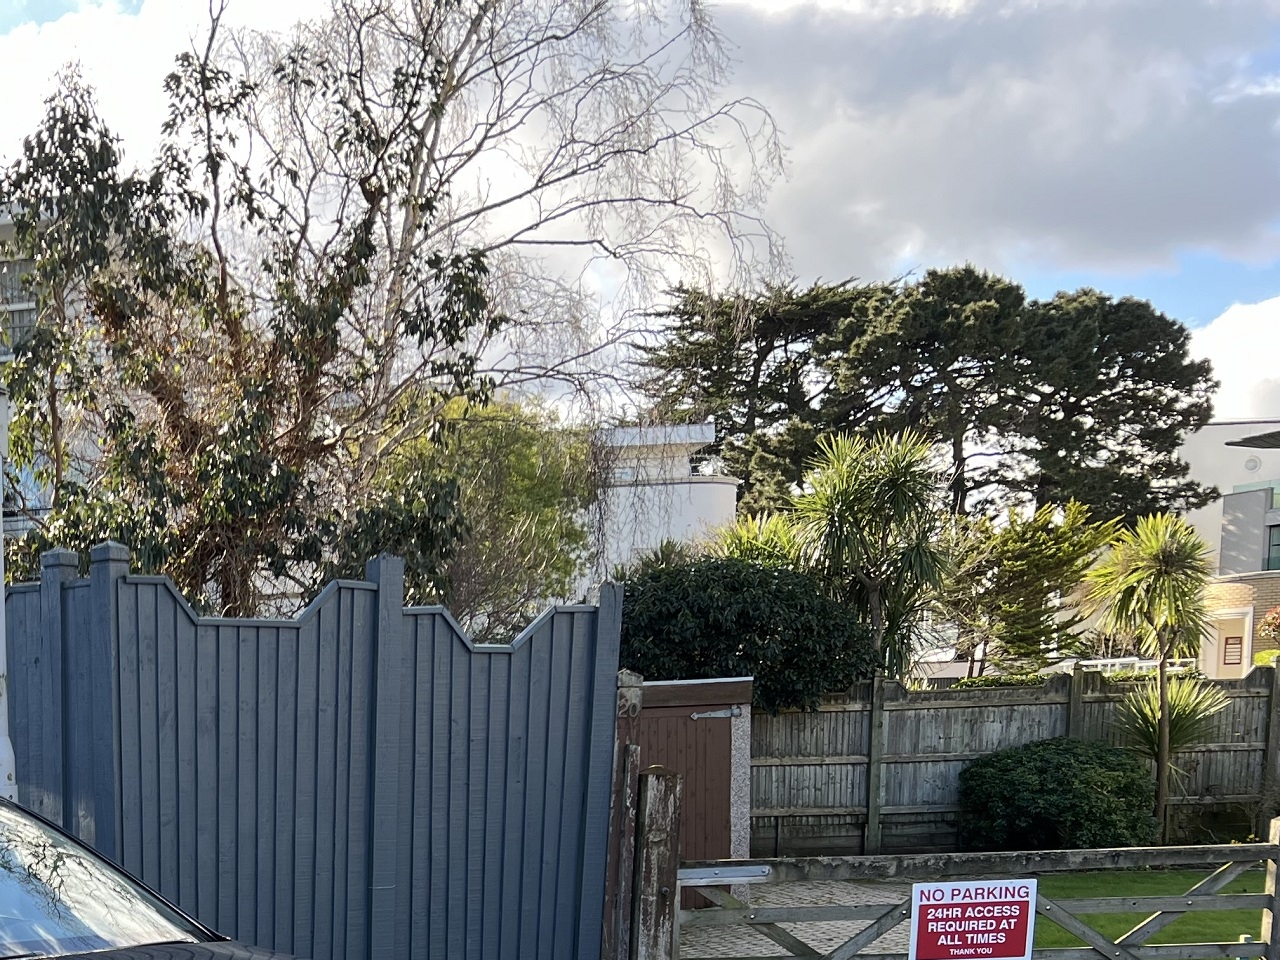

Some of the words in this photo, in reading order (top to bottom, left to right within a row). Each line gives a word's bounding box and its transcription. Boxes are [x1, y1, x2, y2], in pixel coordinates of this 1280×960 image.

[920, 888, 945, 902] NO
[951, 885, 1030, 901] PARKING
[927, 907, 962, 919] 24HR
[964, 905, 1020, 918] ACCESS
[928, 920, 996, 932] REQUIRED
[999, 919, 1017, 930] AT
[937, 934, 962, 945] ALL
[965, 933, 1006, 944] TIMES
